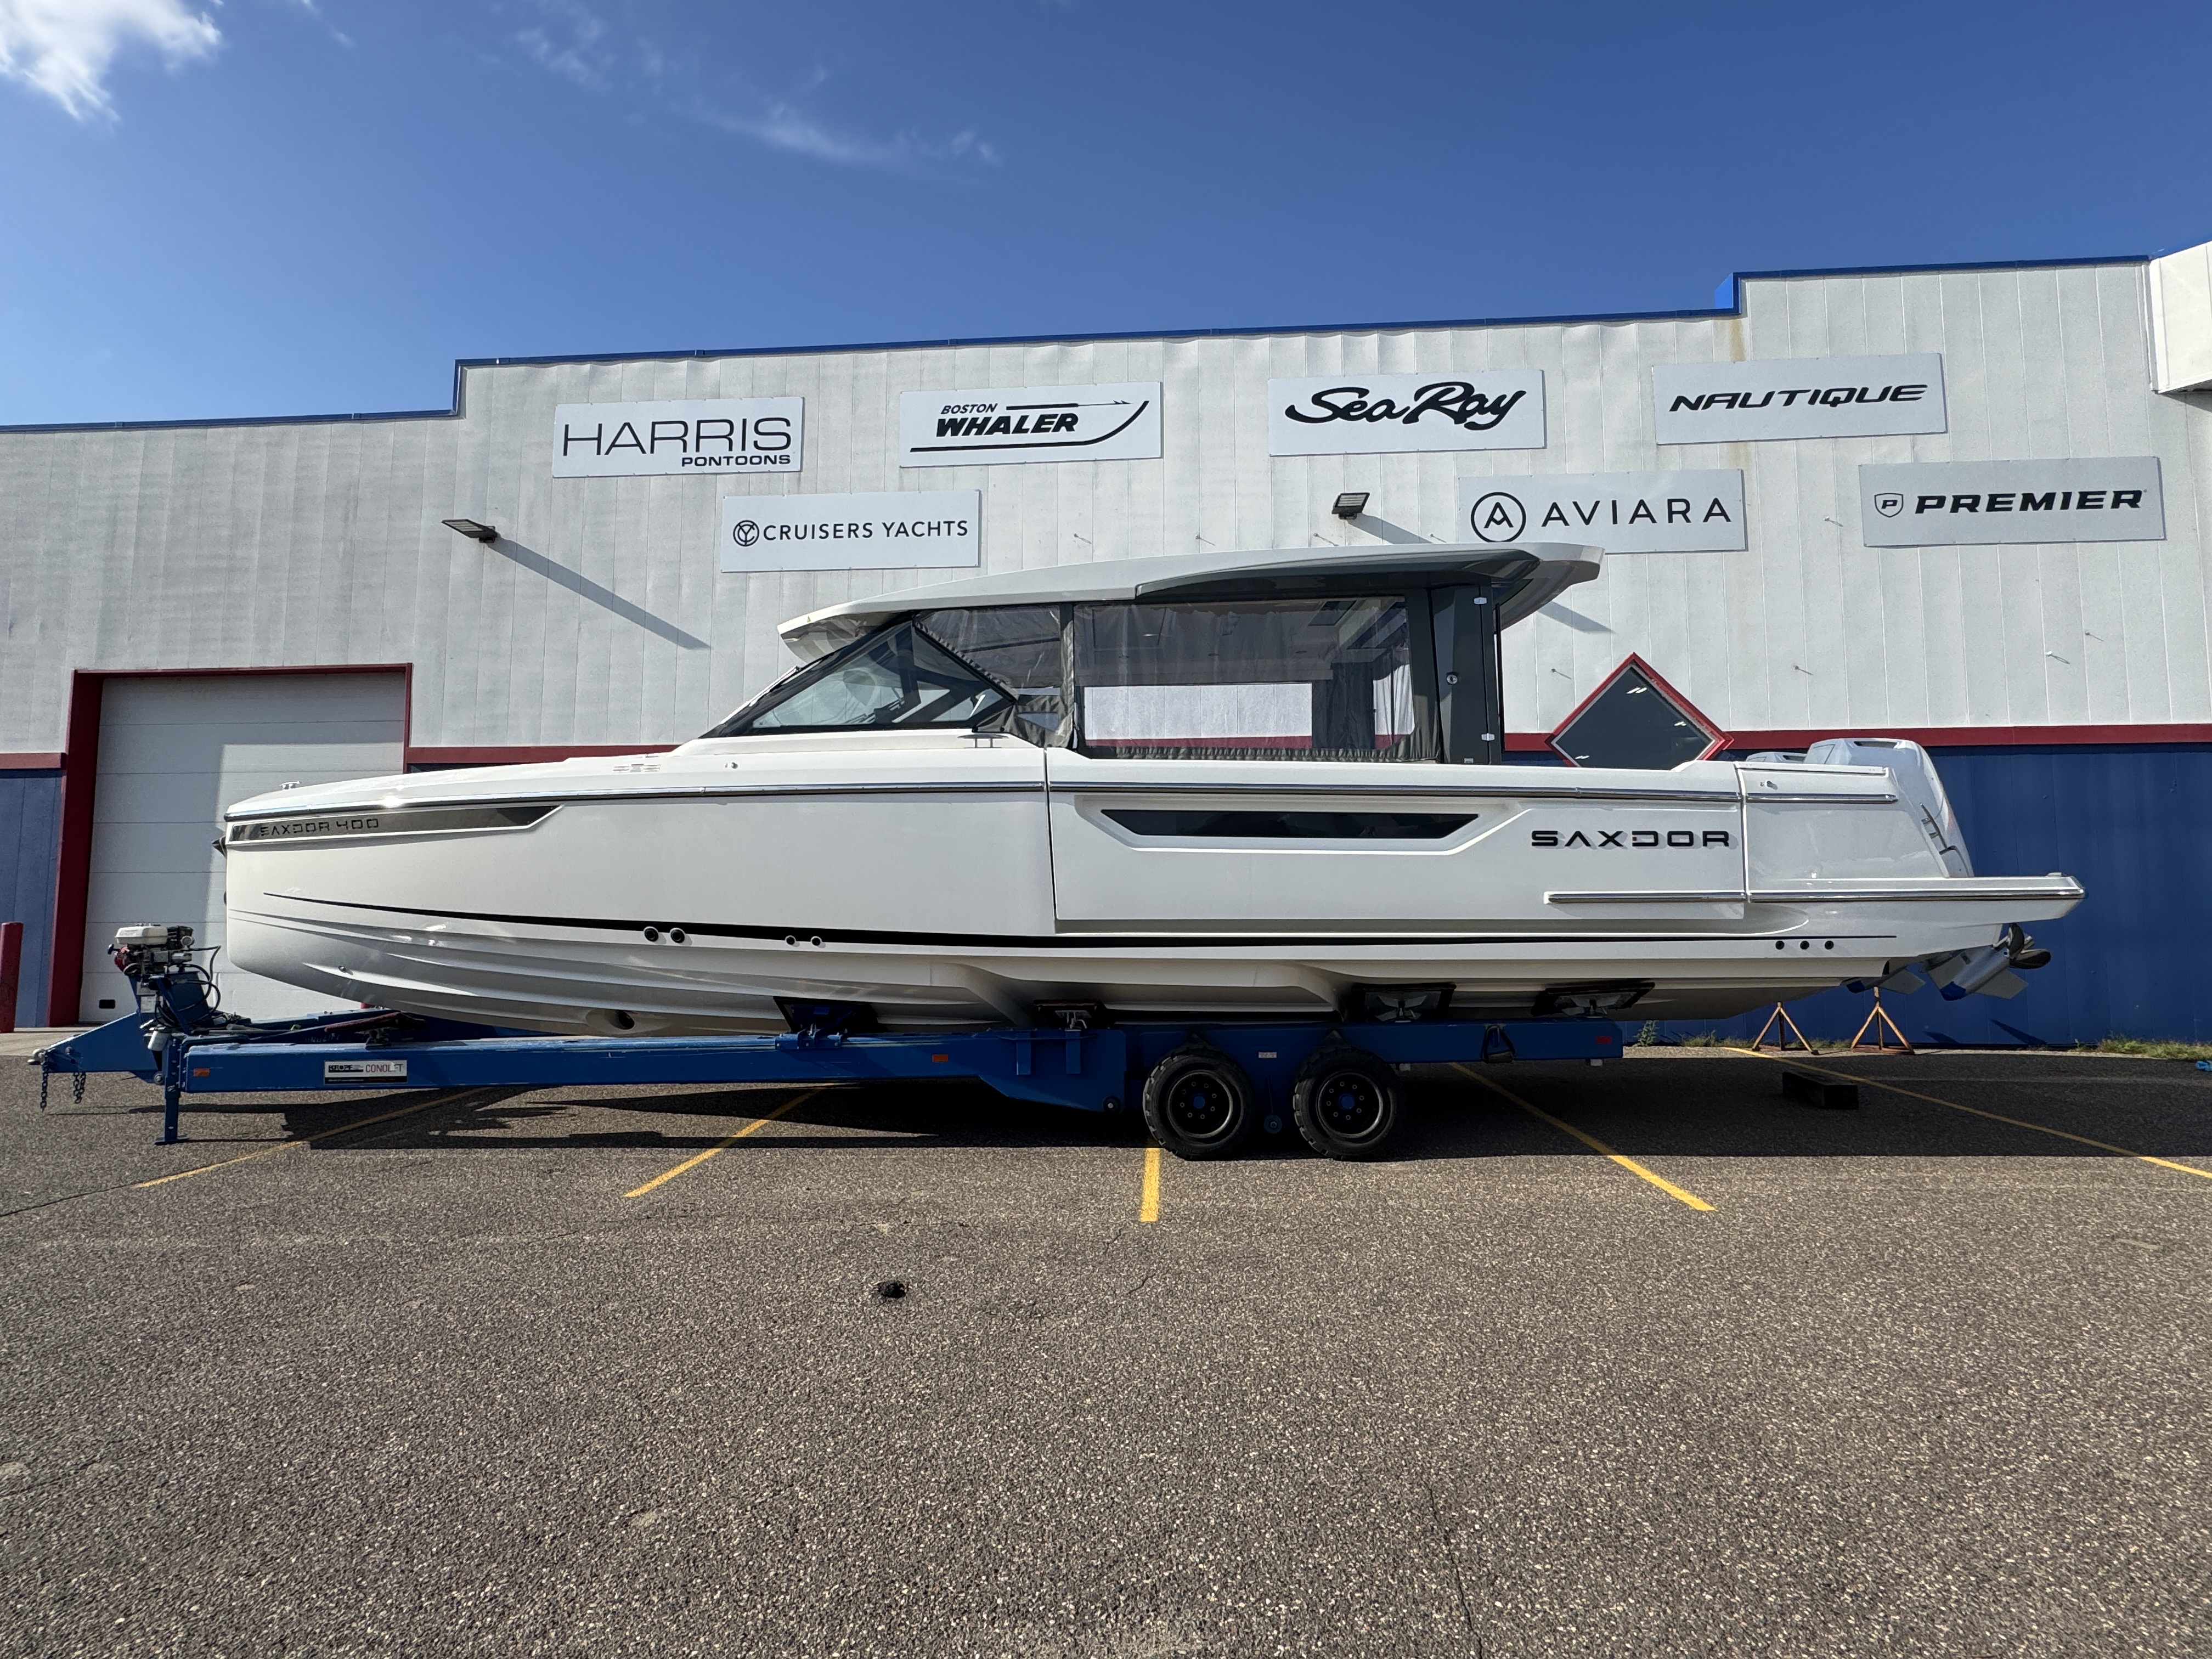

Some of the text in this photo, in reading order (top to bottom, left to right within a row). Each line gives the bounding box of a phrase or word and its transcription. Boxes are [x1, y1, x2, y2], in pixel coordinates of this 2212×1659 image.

[940, 403, 998, 415] BOSTON
[1285, 381, 1527, 431] Sea Ray
[1669, 384, 1928, 412] NAUTIQUE
[563, 417, 791, 456] HARRIS
[936, 413, 1079, 437] WHALER
[681, 455, 791, 467] PONTOONS
[1541, 498, 1731, 527] AVIARA
[1915, 490, 2142, 514] PREMIER
[763, 520, 968, 541] CRUISERS YACHTS
[260, 819, 380, 837] SAXDOR 400
[1531, 830, 1729, 847] SAXDOR
